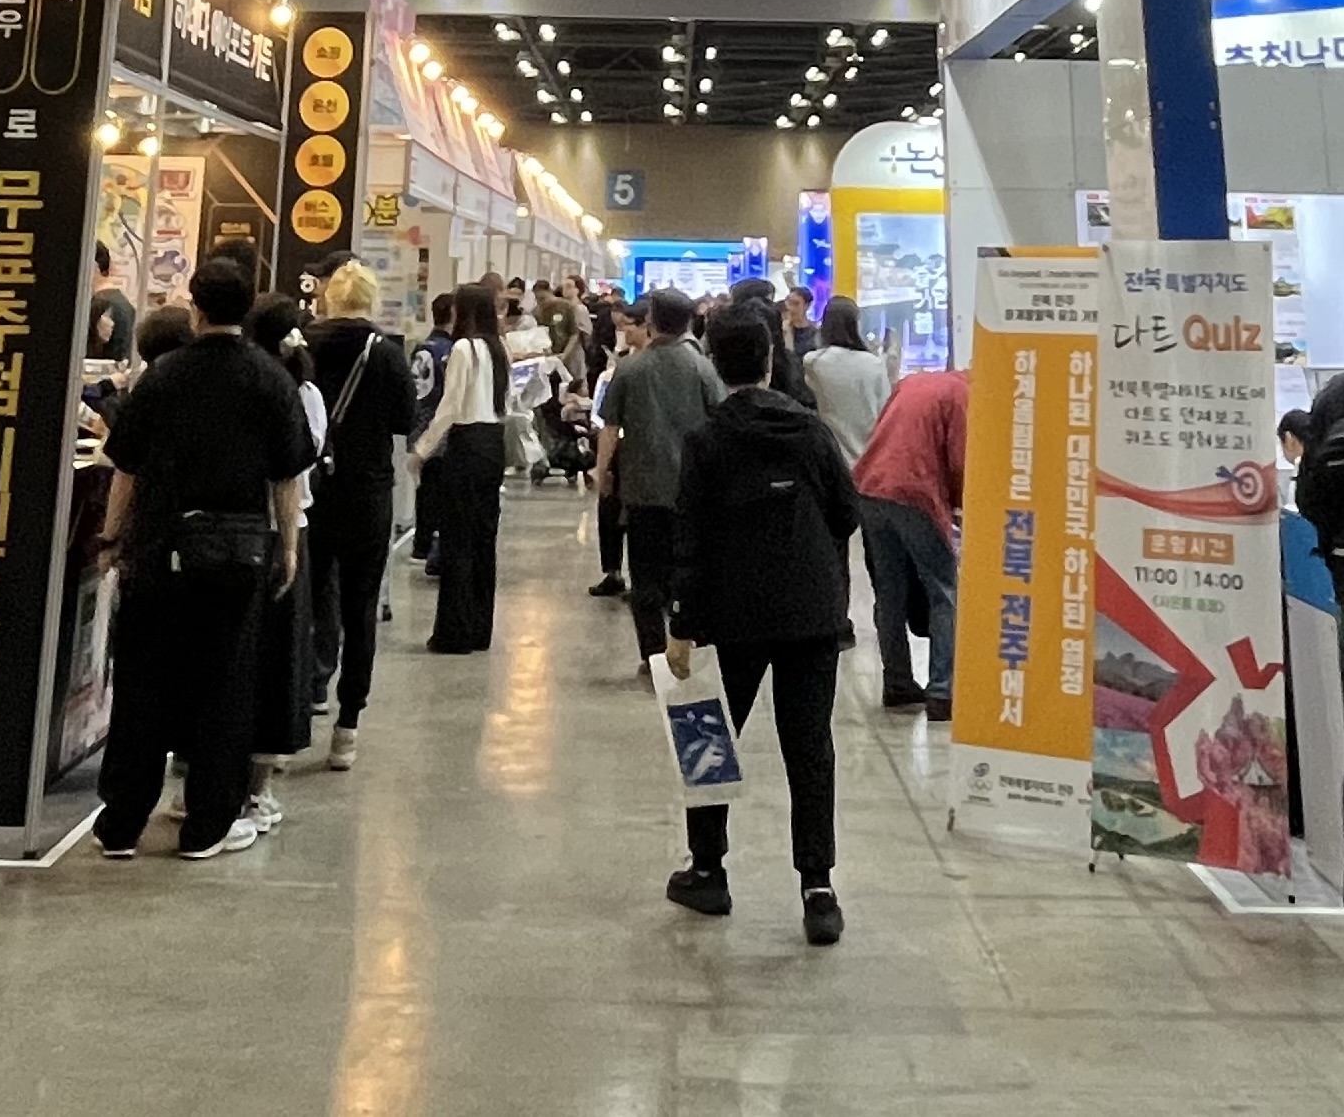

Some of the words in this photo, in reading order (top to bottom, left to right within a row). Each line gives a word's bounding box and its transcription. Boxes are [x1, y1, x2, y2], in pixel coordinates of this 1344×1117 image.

[3, 108, 38, 140] 로
[613, 174, 635, 206] 5
[1112, 315, 1178, 353] 다트
[1069, 351, 1093, 427] 하나된
[1219, 385, 1266, 401] 지도에
[1124, 406, 1172, 422] 다트도
[1125, 430, 1171, 446] 퀴즈도
[1064, 435, 1094, 540] 대한민국
[1002, 509, 1034, 585] 전북
[1134, 566, 1178, 585] 11:00
[1195, 570, 1244, 590] 14:00
